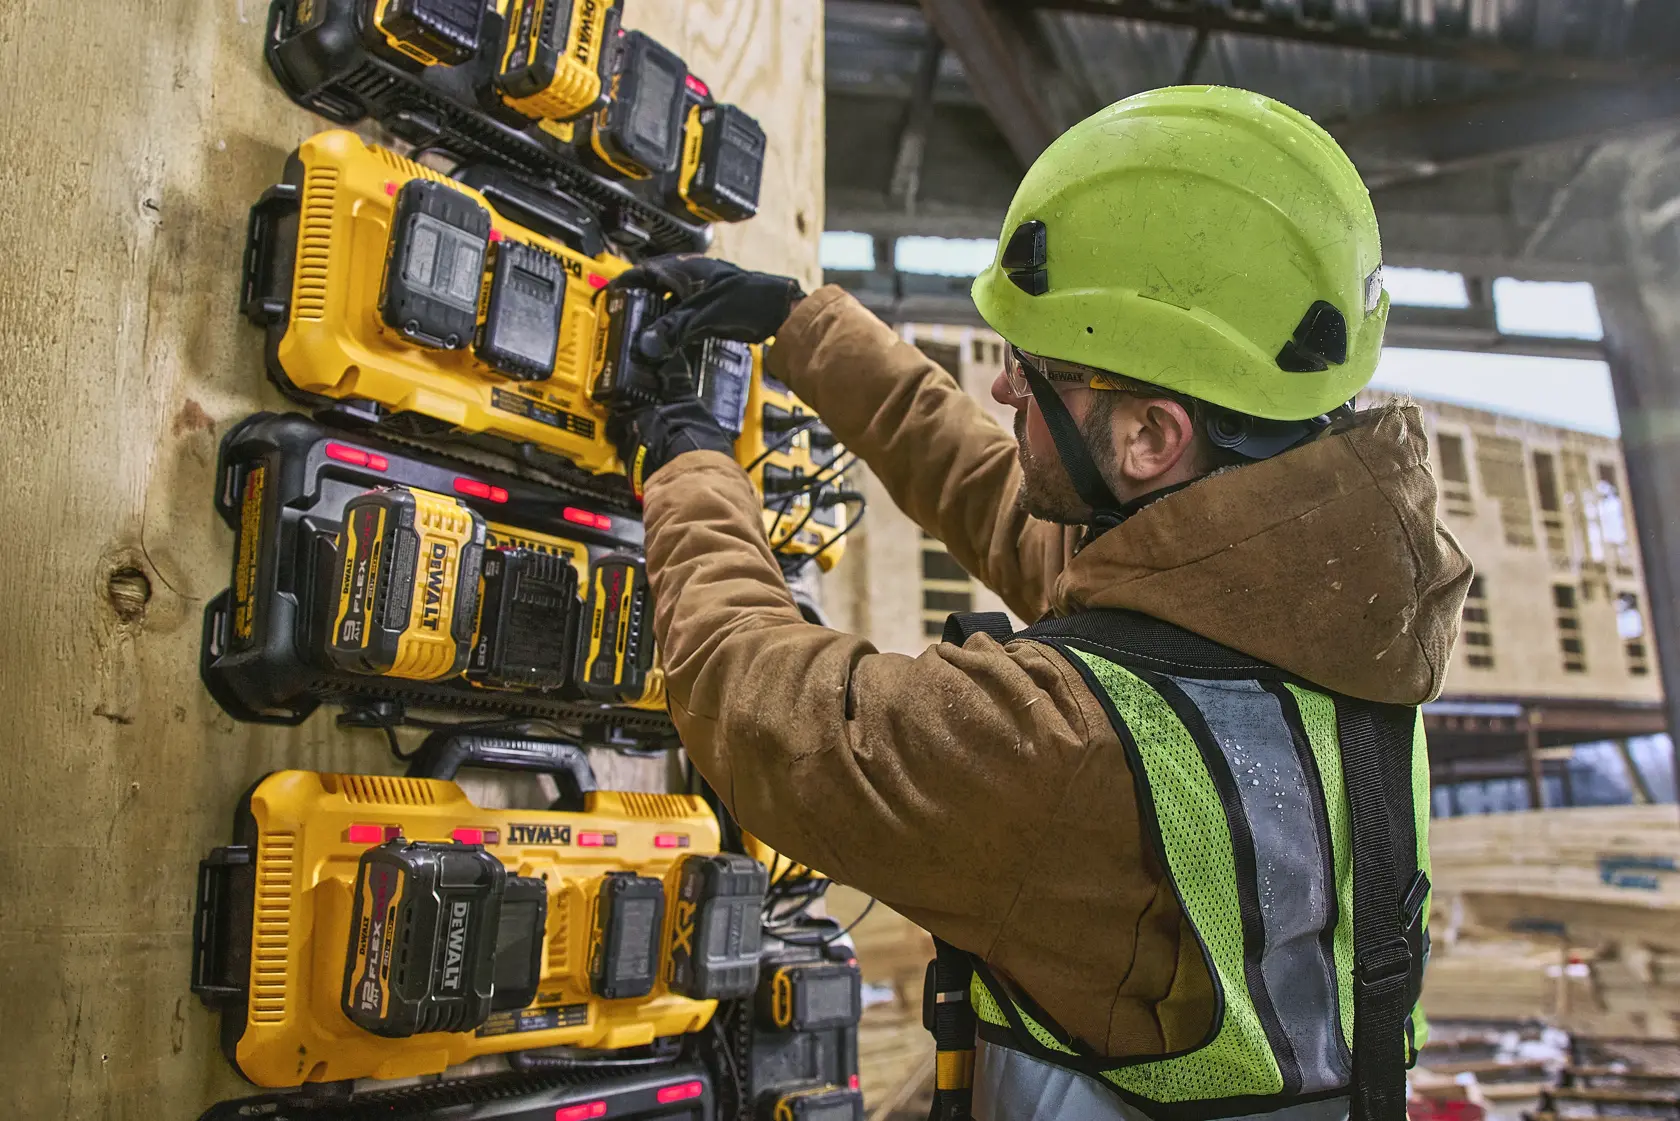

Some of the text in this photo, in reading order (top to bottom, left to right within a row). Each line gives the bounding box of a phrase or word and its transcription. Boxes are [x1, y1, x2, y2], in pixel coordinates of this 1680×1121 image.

[343, 558, 353, 595] DEWALT
[422, 543, 447, 631] DEWALT
[507, 824, 571, 845] DEWALT
[359, 916, 370, 955] DEWALT
[443, 901, 468, 989] DEWALT
[672, 900, 697, 956] XR
